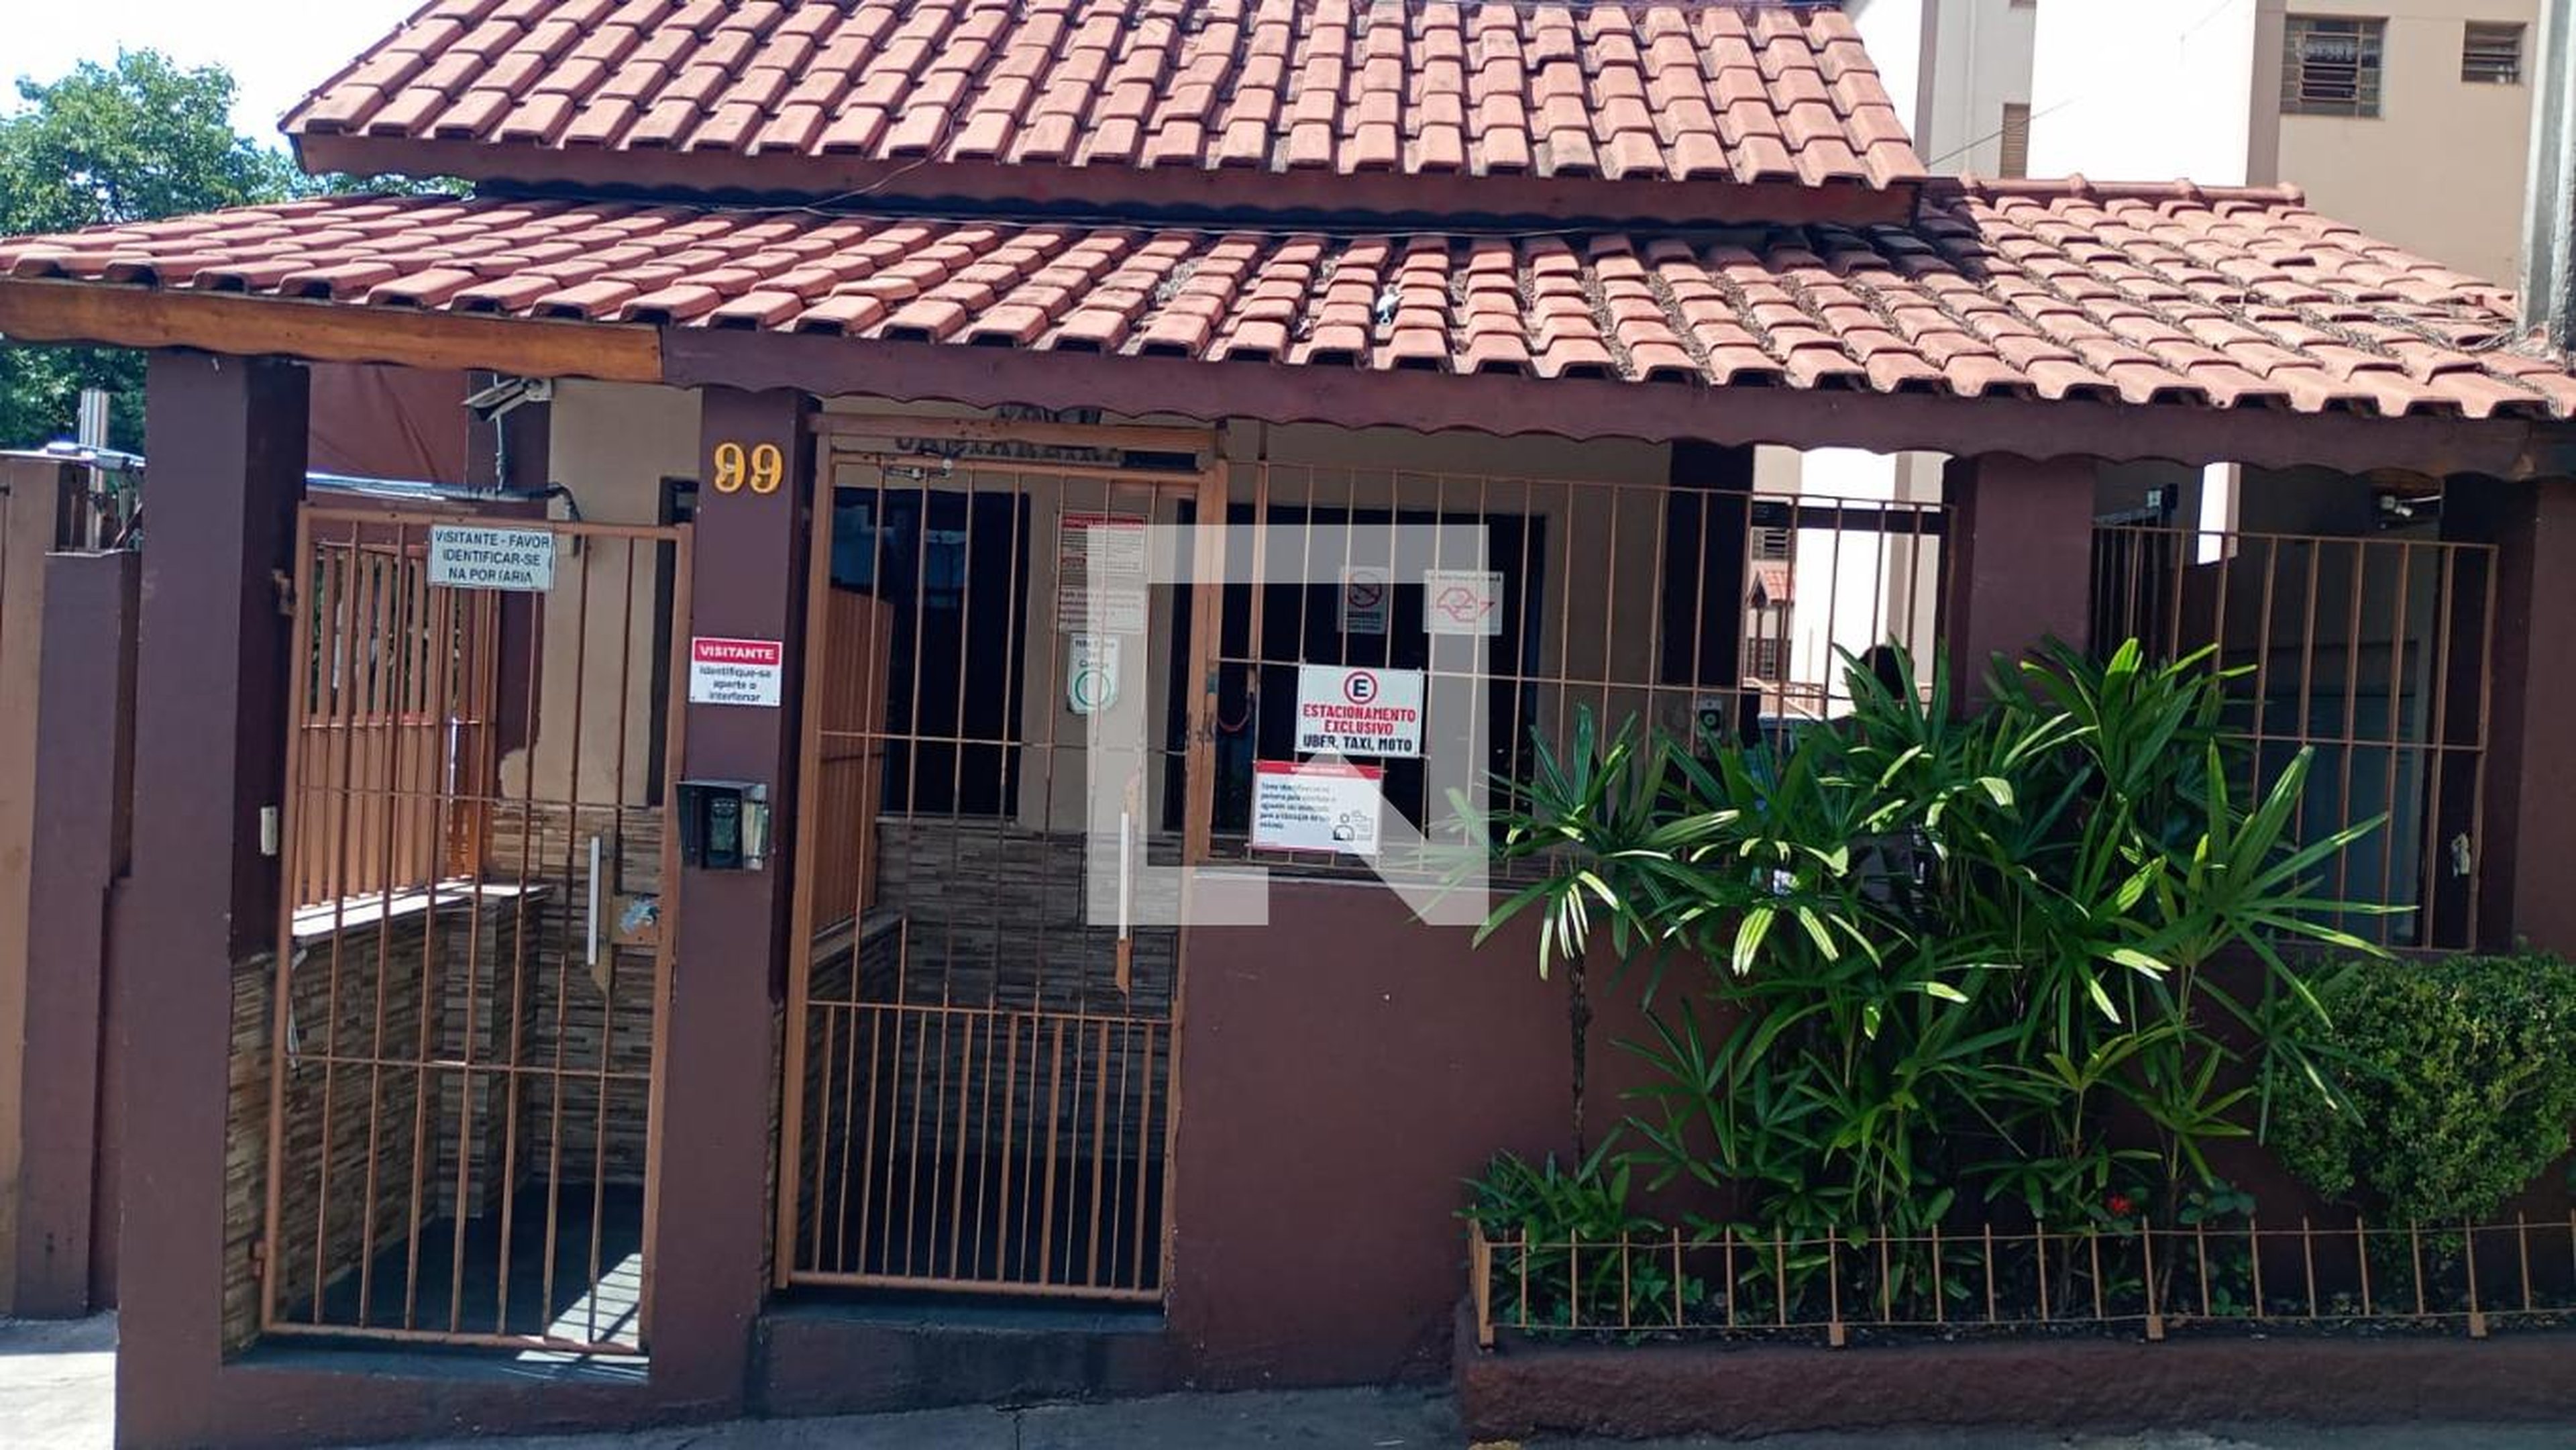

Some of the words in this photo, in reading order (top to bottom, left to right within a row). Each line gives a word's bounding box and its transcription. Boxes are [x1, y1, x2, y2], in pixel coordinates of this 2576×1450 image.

[714, 442, 783, 494] 99
[435, 530, 498, 546] VISITANTE
[509, 534, 549, 548] FAVOR
[443, 548, 541, 566] IDENTIFICAR-SE
[448, 567, 466, 580] NA
[699, 643, 775, 660] VISITANTE
[1352, 678, 1368, 697] E
[1303, 705, 1417, 723] ESTACIONAMENTO
[1324, 720, 1394, 735] EXCLUSIVO
[1344, 736, 1375, 752] TAXI,
[1378, 738, 1413, 752] MOTO
